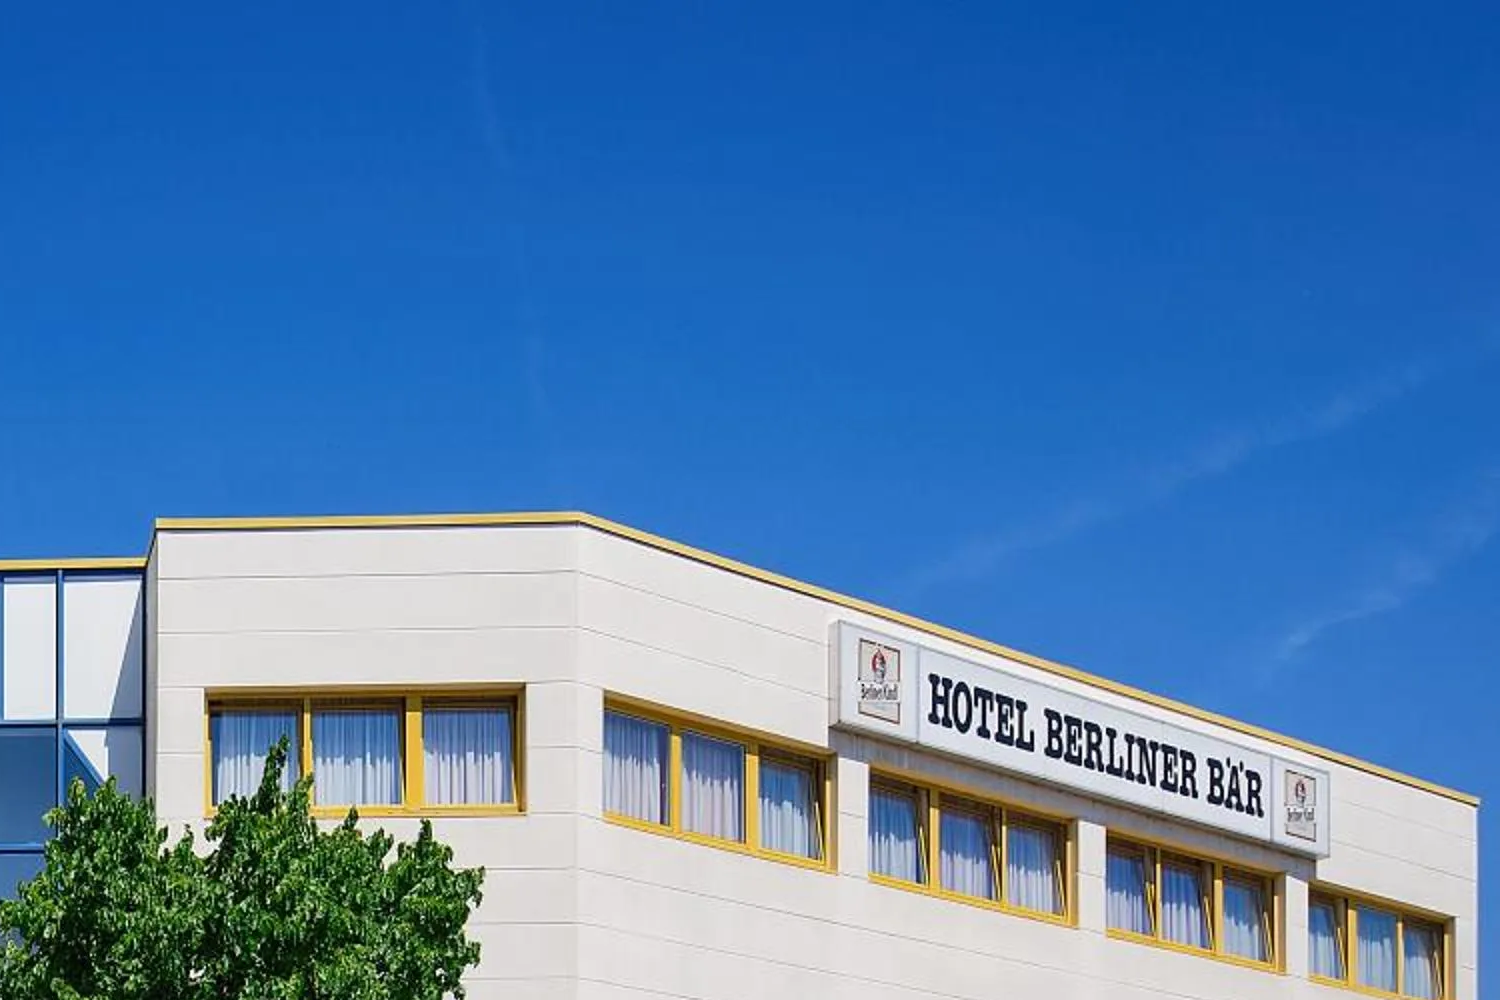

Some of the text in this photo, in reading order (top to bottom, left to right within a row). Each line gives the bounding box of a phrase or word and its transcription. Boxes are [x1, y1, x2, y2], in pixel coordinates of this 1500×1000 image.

[927, 673, 1265, 818] HOTEL BERLINER BÄR
